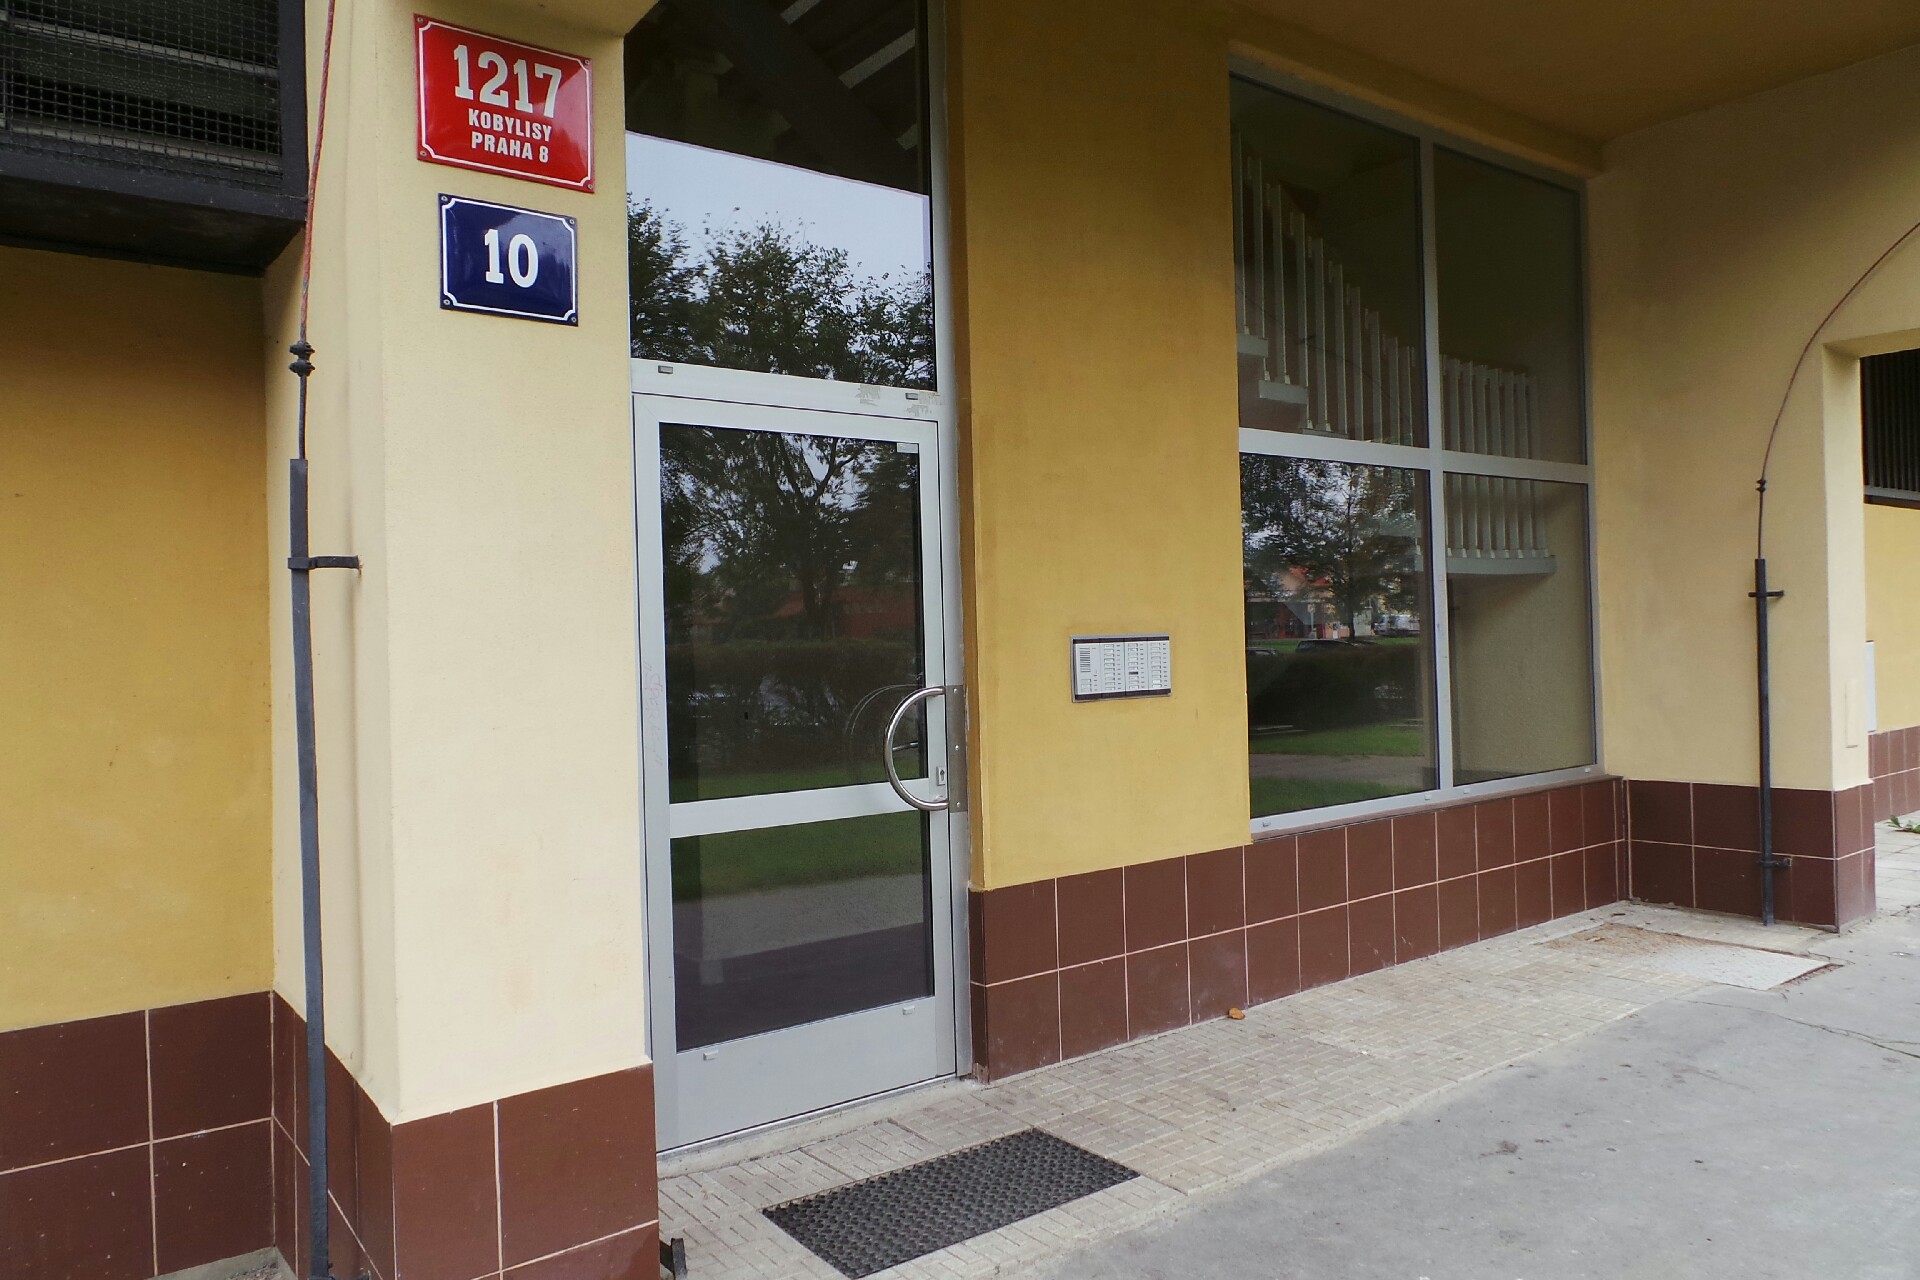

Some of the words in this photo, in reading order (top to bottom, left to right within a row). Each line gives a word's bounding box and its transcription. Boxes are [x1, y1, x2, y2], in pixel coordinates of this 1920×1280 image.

[454, 44, 562, 118] 1217
[468, 109, 552, 142] KOBYLISY
[471, 131, 533, 161] PRAHA
[539, 146, 549, 163] 8
[484, 229, 539, 288] 10
